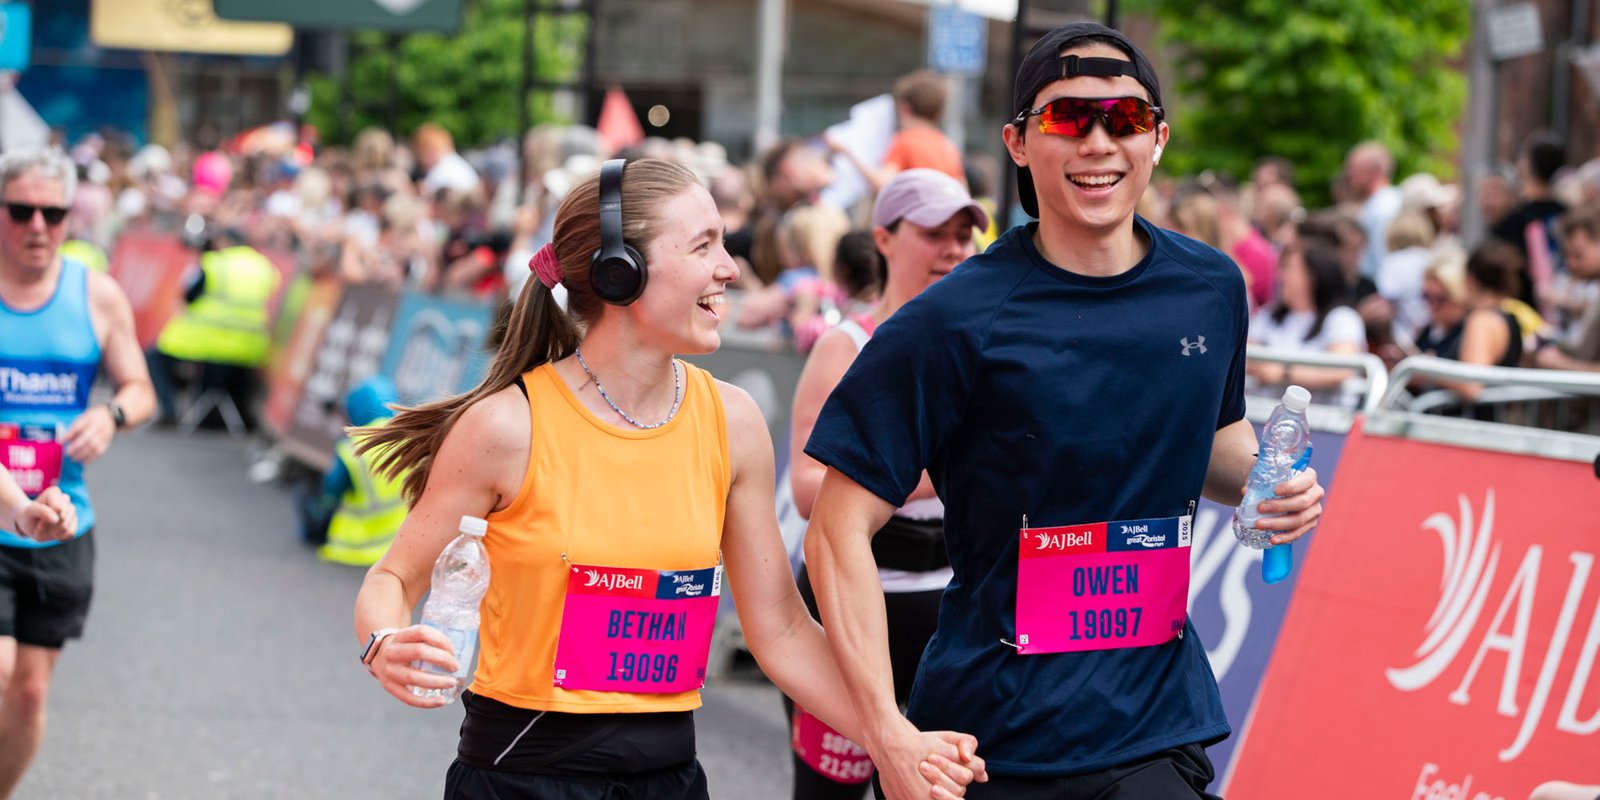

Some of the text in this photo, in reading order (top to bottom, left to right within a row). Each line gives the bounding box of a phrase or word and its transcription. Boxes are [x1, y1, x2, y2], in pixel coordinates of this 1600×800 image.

[1049, 531, 1093, 551] AJBell
[1127, 524, 1149, 535] AJBell
[1147, 534, 1166, 543] bristol
[597, 573, 643, 591] AJBell
[1073, 564, 1139, 596] OWEN
[607, 610, 687, 641] BETHAN
[1069, 607, 1143, 641] 19097
[606, 652, 679, 683] 19096
